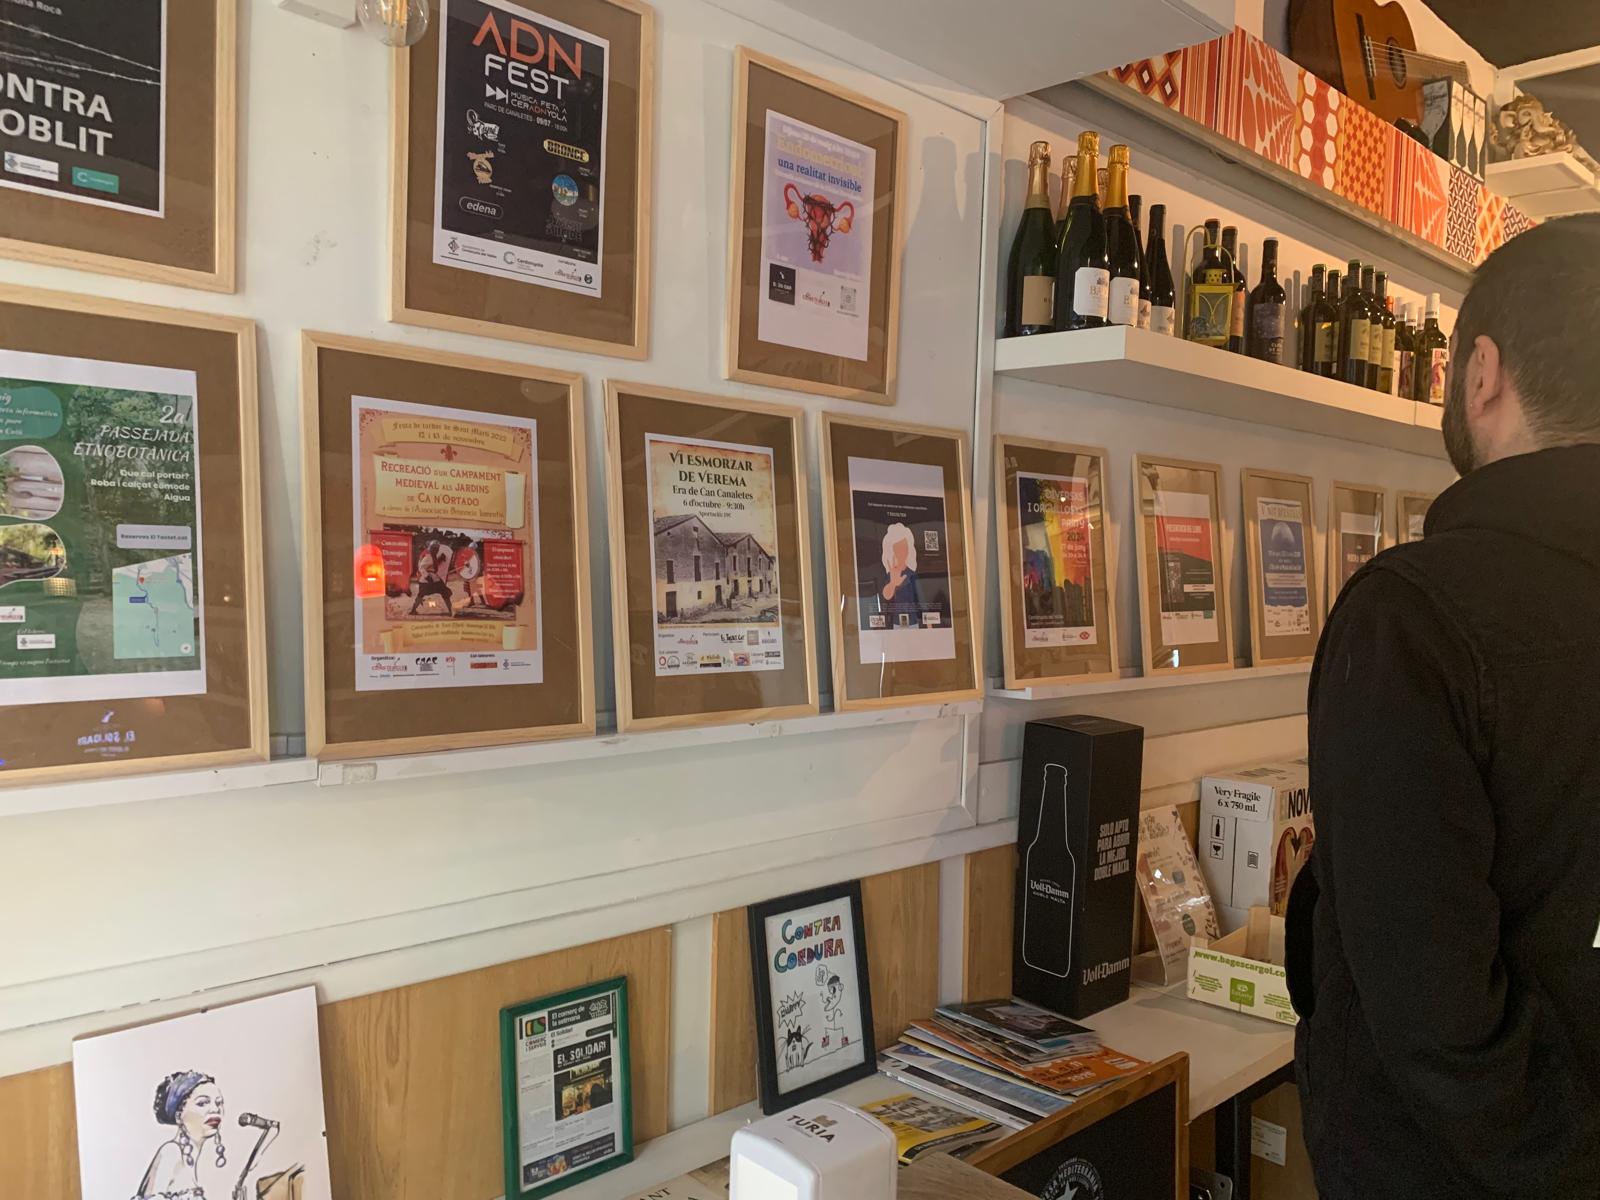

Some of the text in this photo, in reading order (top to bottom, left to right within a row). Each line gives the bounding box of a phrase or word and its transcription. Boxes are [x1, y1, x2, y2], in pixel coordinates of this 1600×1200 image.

[36, 0, 63, 15] Roca
[472, 11, 582, 80] ADN
[484, 53, 570, 100] FEST
[0, 72, 113, 123] NTRA
[510, 99, 568, 122] CERADNYOLA
[777, 158, 862, 192] una realitat invisible
[466, 200, 497, 216] edena
[159, 405, 185, 424] 2a
[99, 424, 191, 443] PASSEJADA
[669, 450, 754, 472] VI ESMORZAR
[119, 469, 190, 480] Que cal portar?
[450, 468, 502, 482] CAMPAMENT
[679, 470, 748, 487] DE VEREMA
[90, 478, 116, 487] Roba
[121, 480, 151, 490] calçat
[395, 478, 439, 490] MEDIEVAL
[454, 483, 490, 494] JARDINS
[672, 485, 754, 500] Era de Can Canaletes
[164, 493, 191, 503] Aigua
[417, 492, 431, 503] CA
[688, 499, 722, 509] d'octubre
[1214, 786, 1261, 802] Very Fragile
[1217, 799, 1223, 807] 6
[1231, 800, 1244, 810] 750
[1244, 803, 1258, 813] ml.
[1288, 788, 1312, 819] NOV
[1100, 822, 1114, 838] SOLO
[1114, 818, 1129, 834] APTO
[1097, 837, 1112, 853] PARA
[1106, 846, 1127, 863] MEJOR
[1112, 859, 1130, 875] MALTA
[1030, 879, 1070, 899] Voll-Damm
[781, 914, 841, 945] CONTRA
[774, 937, 845, 974] CORDURA
[1082, 957, 1130, 986] Voll-Damm
[551, 1005, 586, 1020] El comerç de
[551, 1015, 581, 1027] la setmana
[557, 1040, 607, 1066] EL SOLIDARI
[786, 1113, 837, 1144] TURIA
